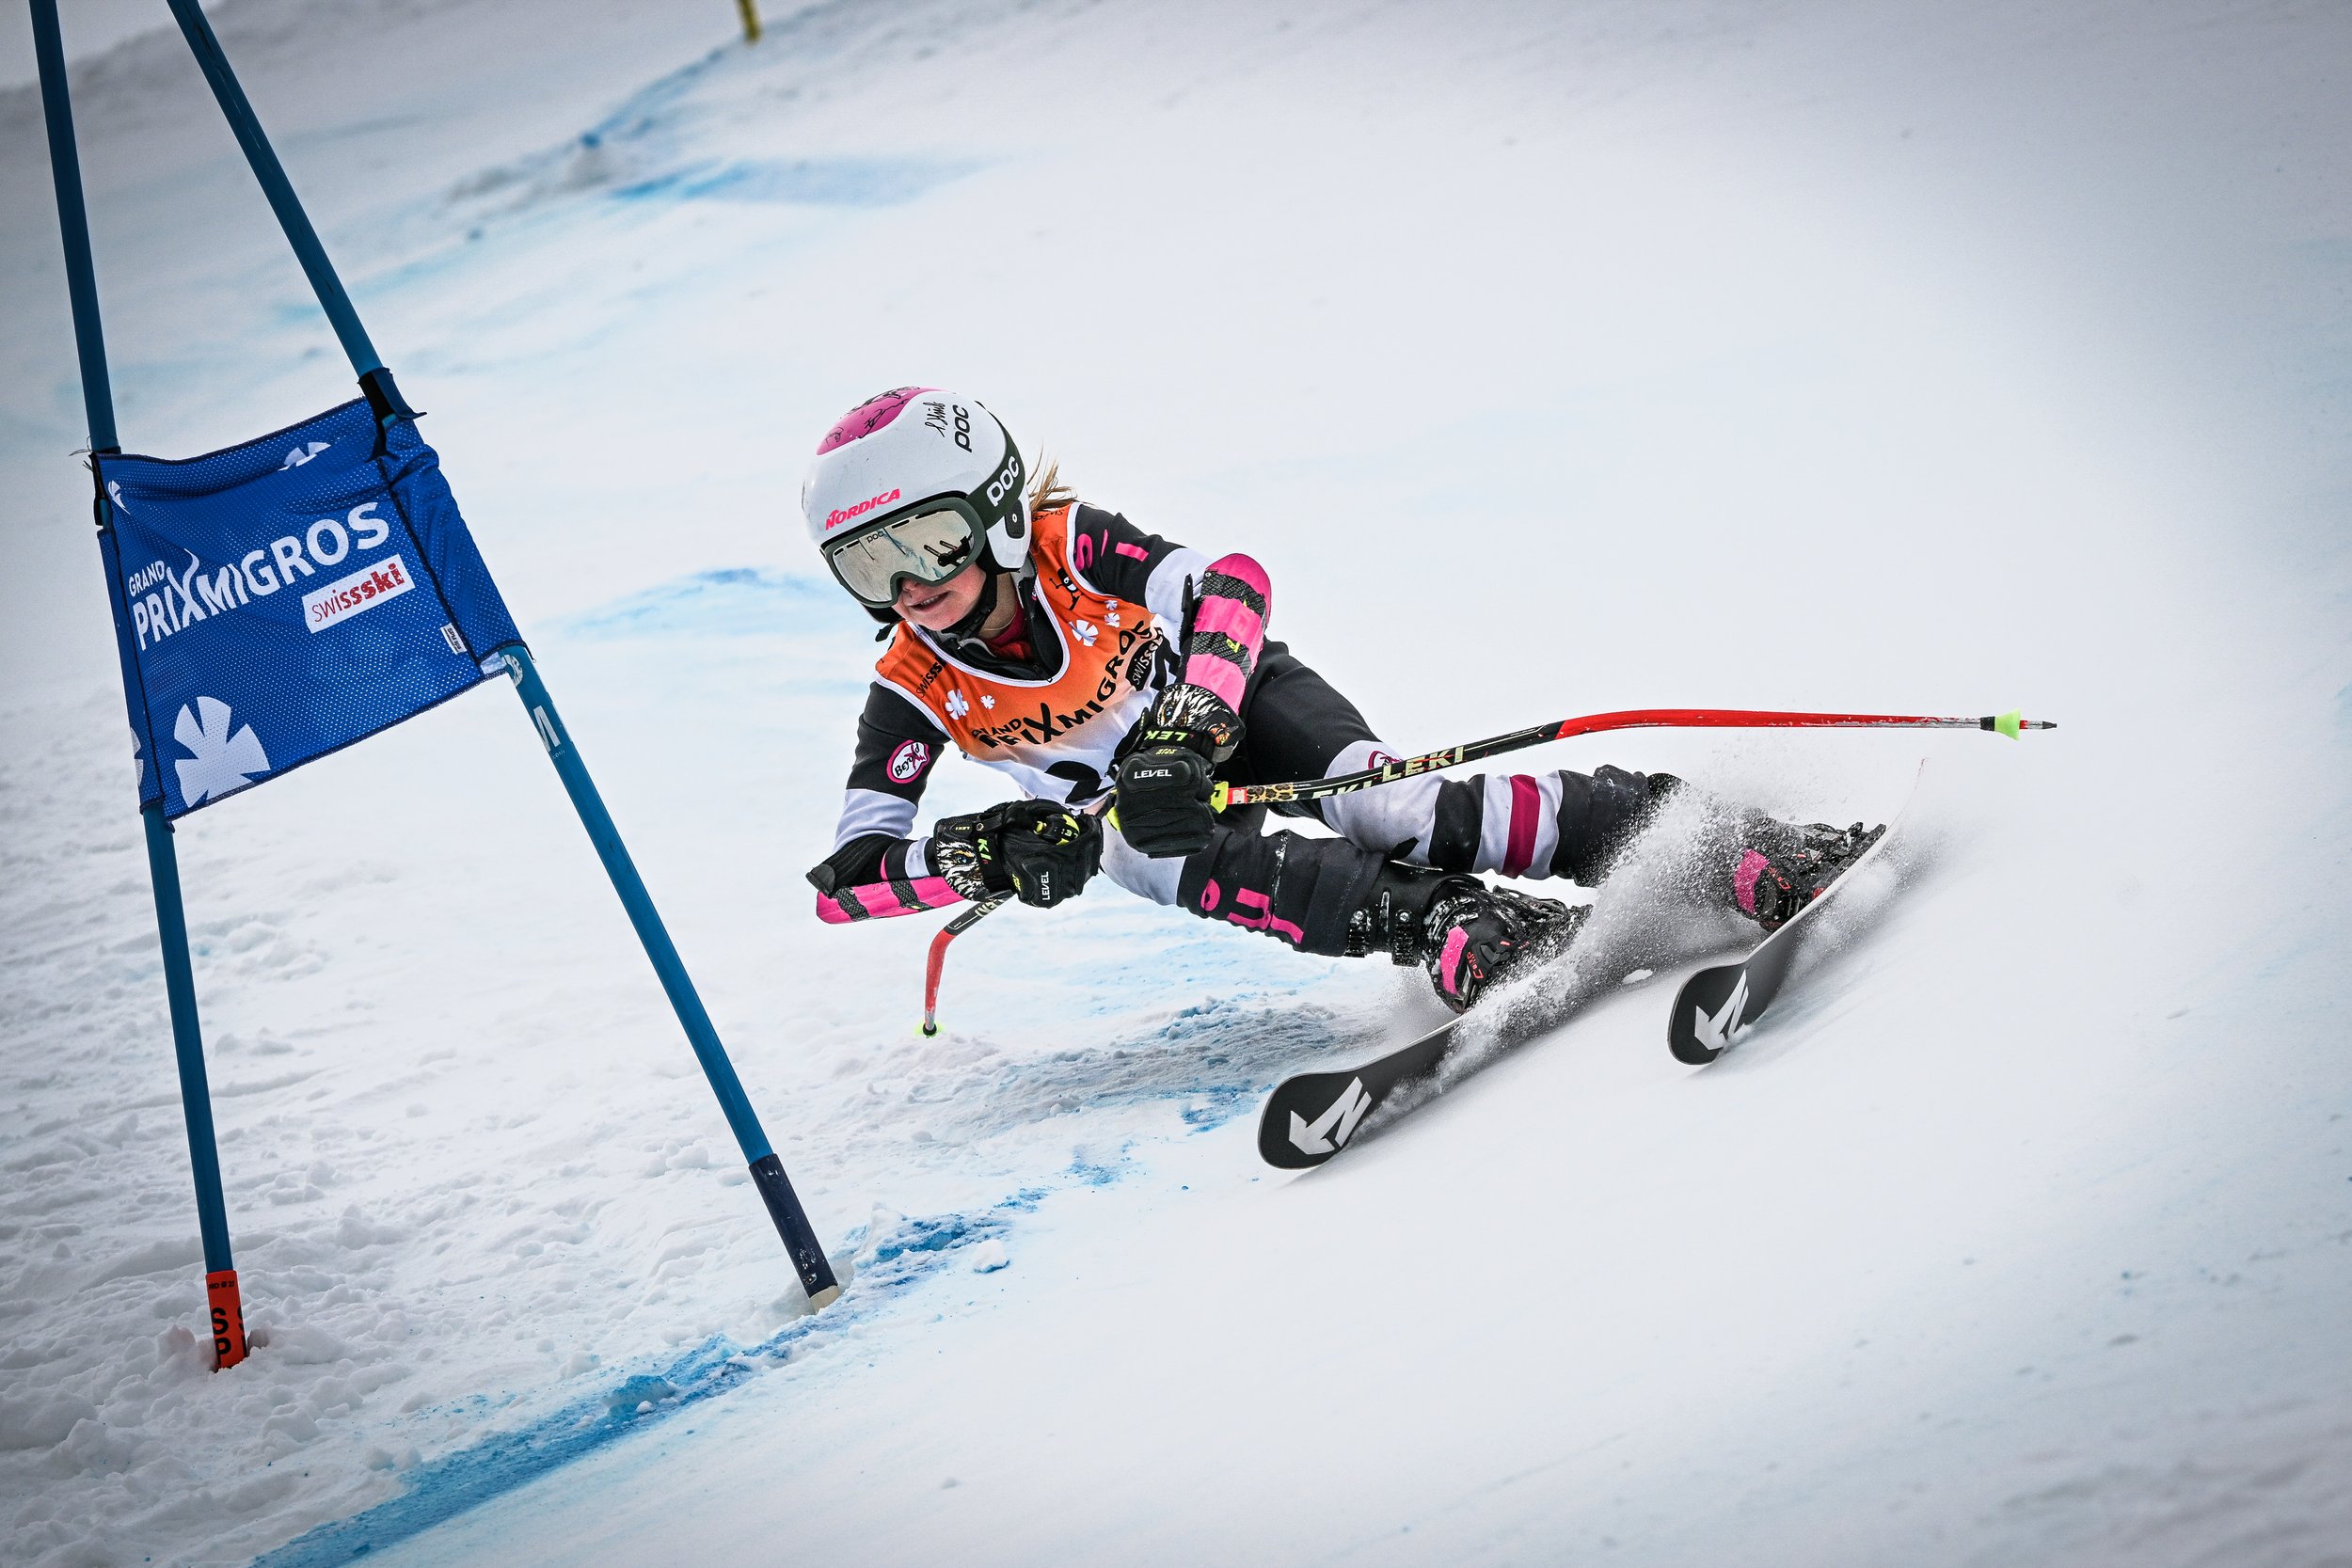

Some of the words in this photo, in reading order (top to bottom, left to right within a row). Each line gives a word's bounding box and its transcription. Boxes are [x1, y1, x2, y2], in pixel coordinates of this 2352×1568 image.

[825, 488, 900, 531] NORDICA
[128, 560, 166, 597] GRAND
[311, 562, 405, 623] swissski
[1134, 769, 1172, 779] LEVEL
[1382, 745, 1465, 783] LEKI
[1041, 871, 1050, 901] LEVEL
